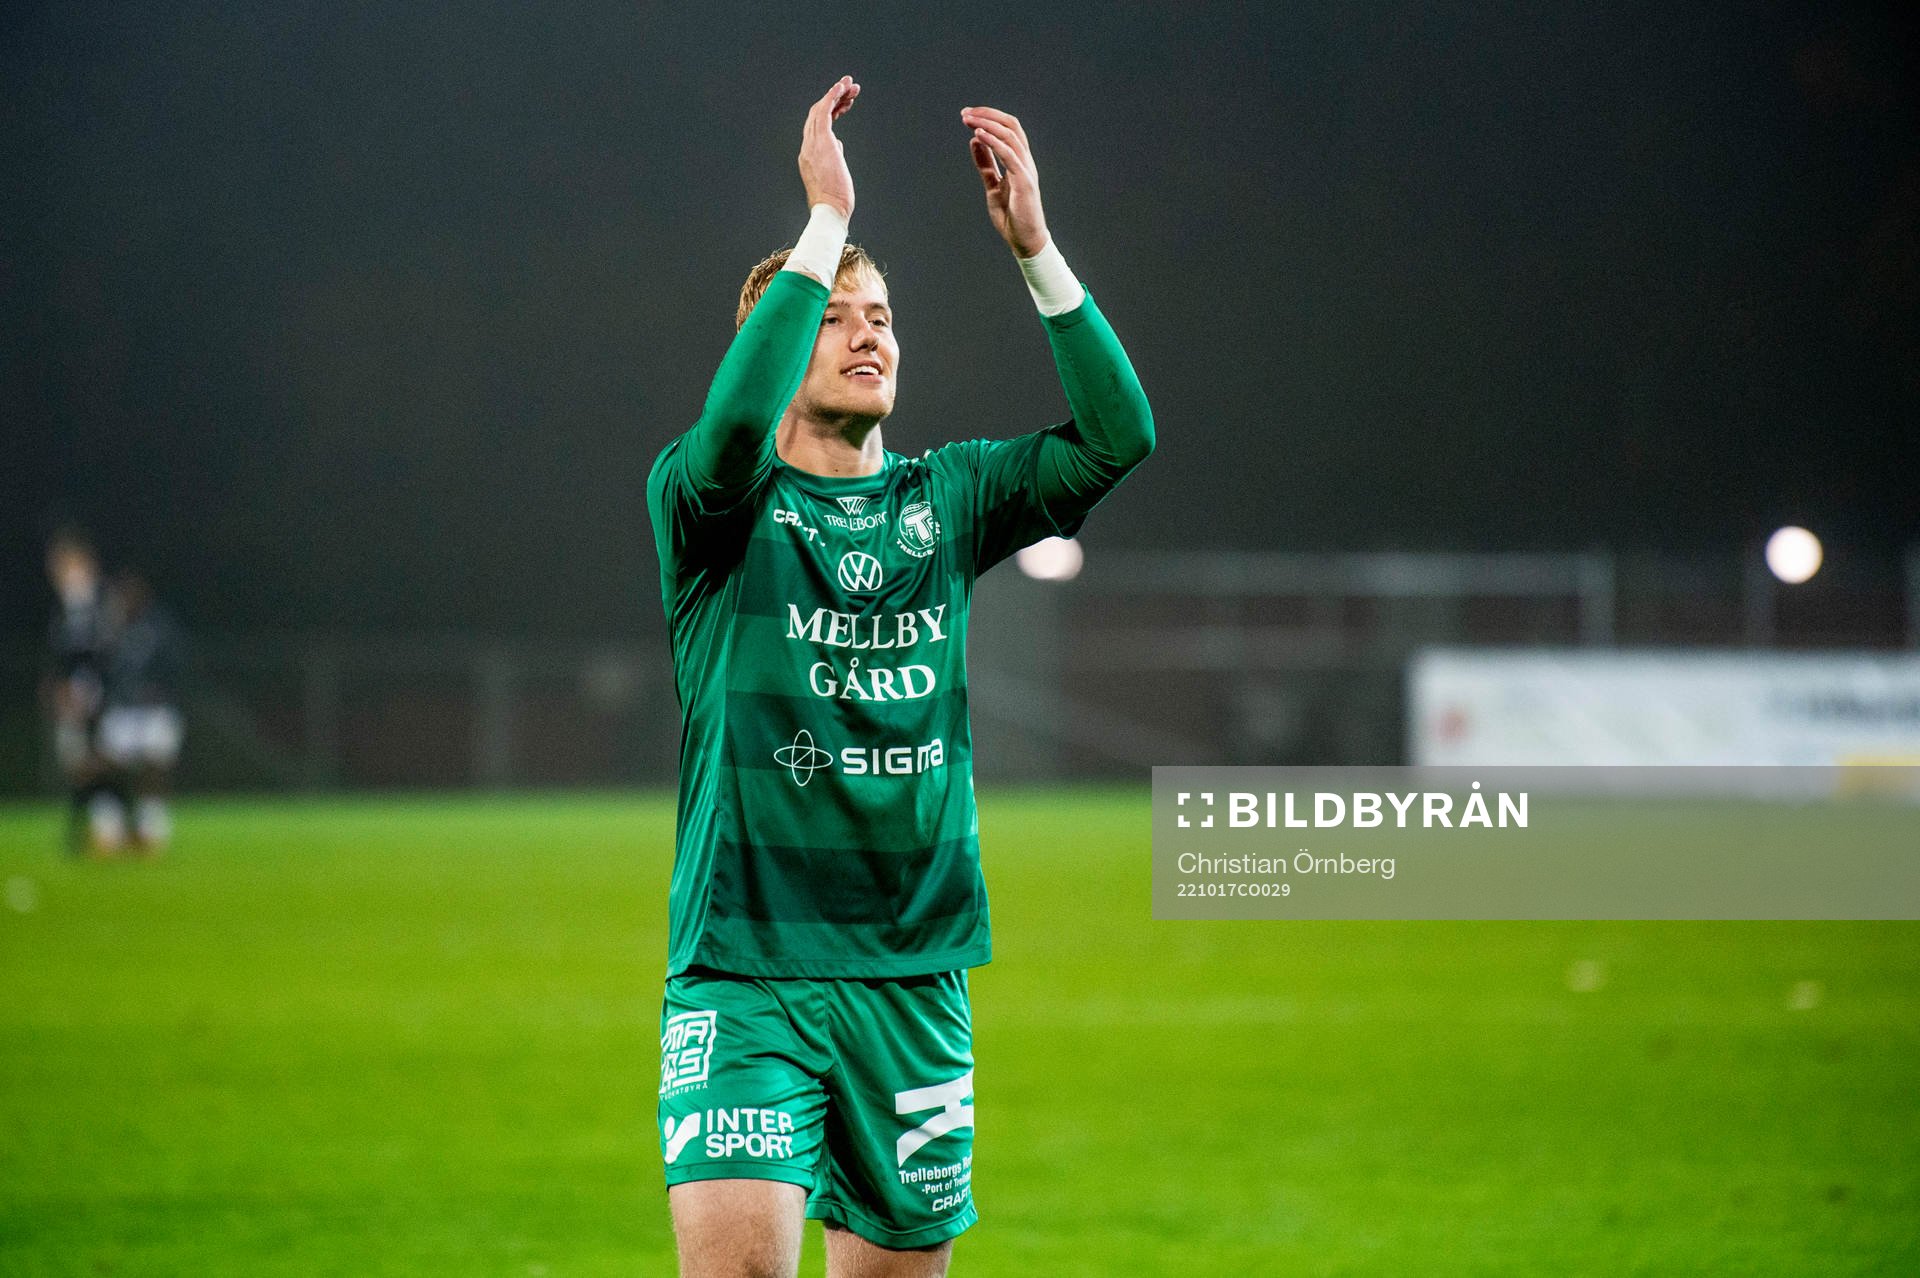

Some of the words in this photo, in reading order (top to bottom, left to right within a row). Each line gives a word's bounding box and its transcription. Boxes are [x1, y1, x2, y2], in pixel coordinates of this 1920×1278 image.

[773, 509, 819, 542] CRT
[786, 603, 947, 650] MELLBY
[809, 657, 936, 701] GÅRD
[706, 1108, 794, 1134] INTER
[705, 1133, 793, 1159] SPORT
[898, 1163, 961, 1184] Trelleborgs
[945, 1181, 953, 1190] of
